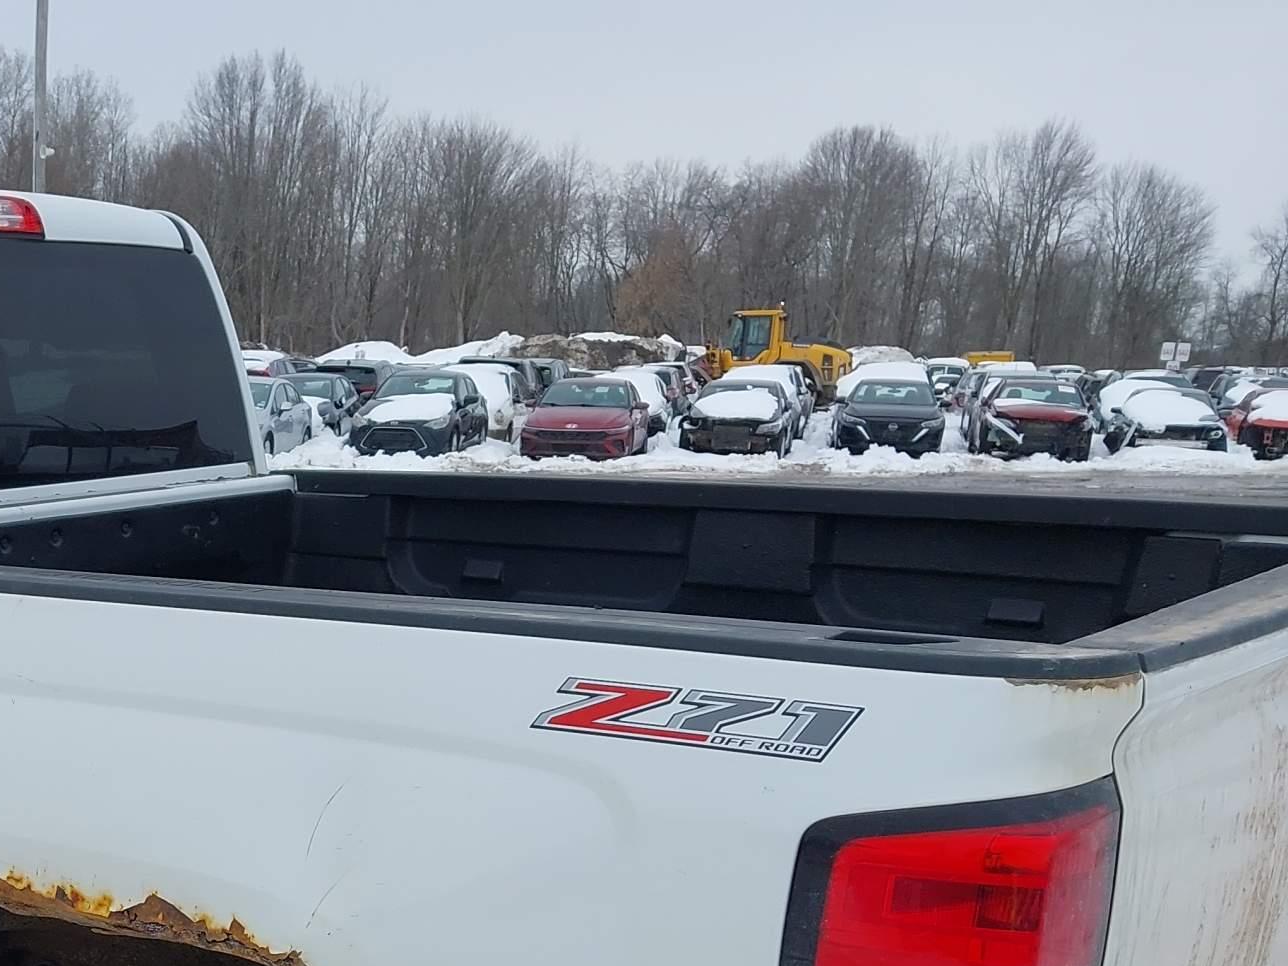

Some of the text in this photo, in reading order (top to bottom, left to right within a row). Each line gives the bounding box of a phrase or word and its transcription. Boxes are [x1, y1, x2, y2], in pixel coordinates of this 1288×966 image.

[530, 677, 865, 763] Z71
[710, 735, 824, 758] OFF ROAD
